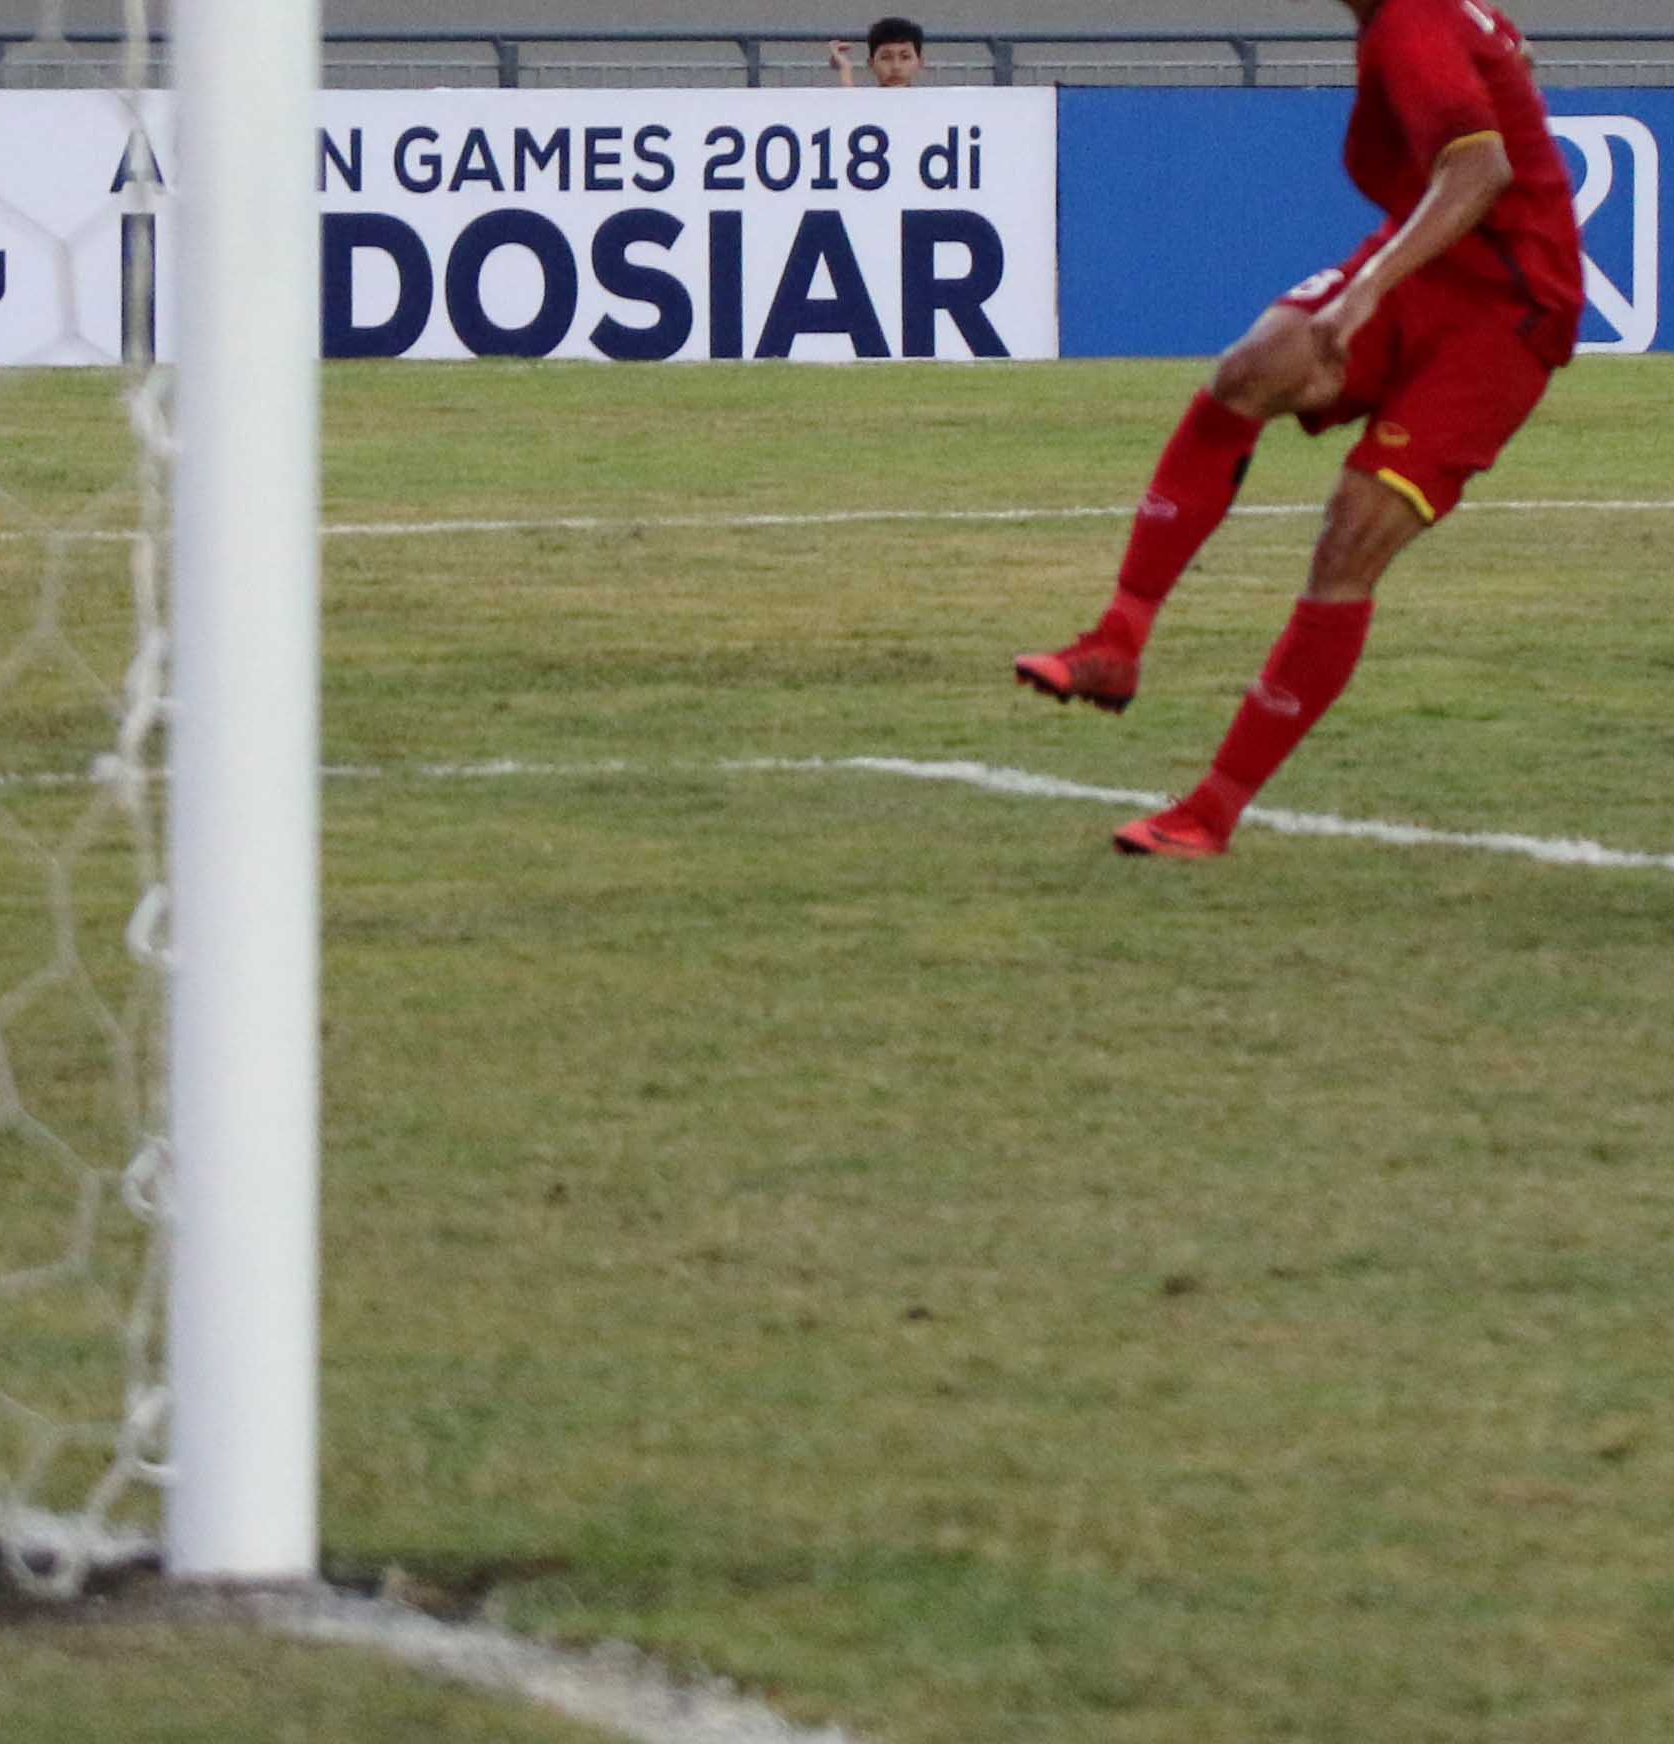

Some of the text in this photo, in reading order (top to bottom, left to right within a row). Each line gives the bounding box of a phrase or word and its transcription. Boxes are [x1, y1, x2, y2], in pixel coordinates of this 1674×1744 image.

[393, 124, 675, 194] GAMES
[703, 124, 891, 193] 2018
[918, 124, 982, 191] di
[121, 208, 1011, 361] IDOSIAR
